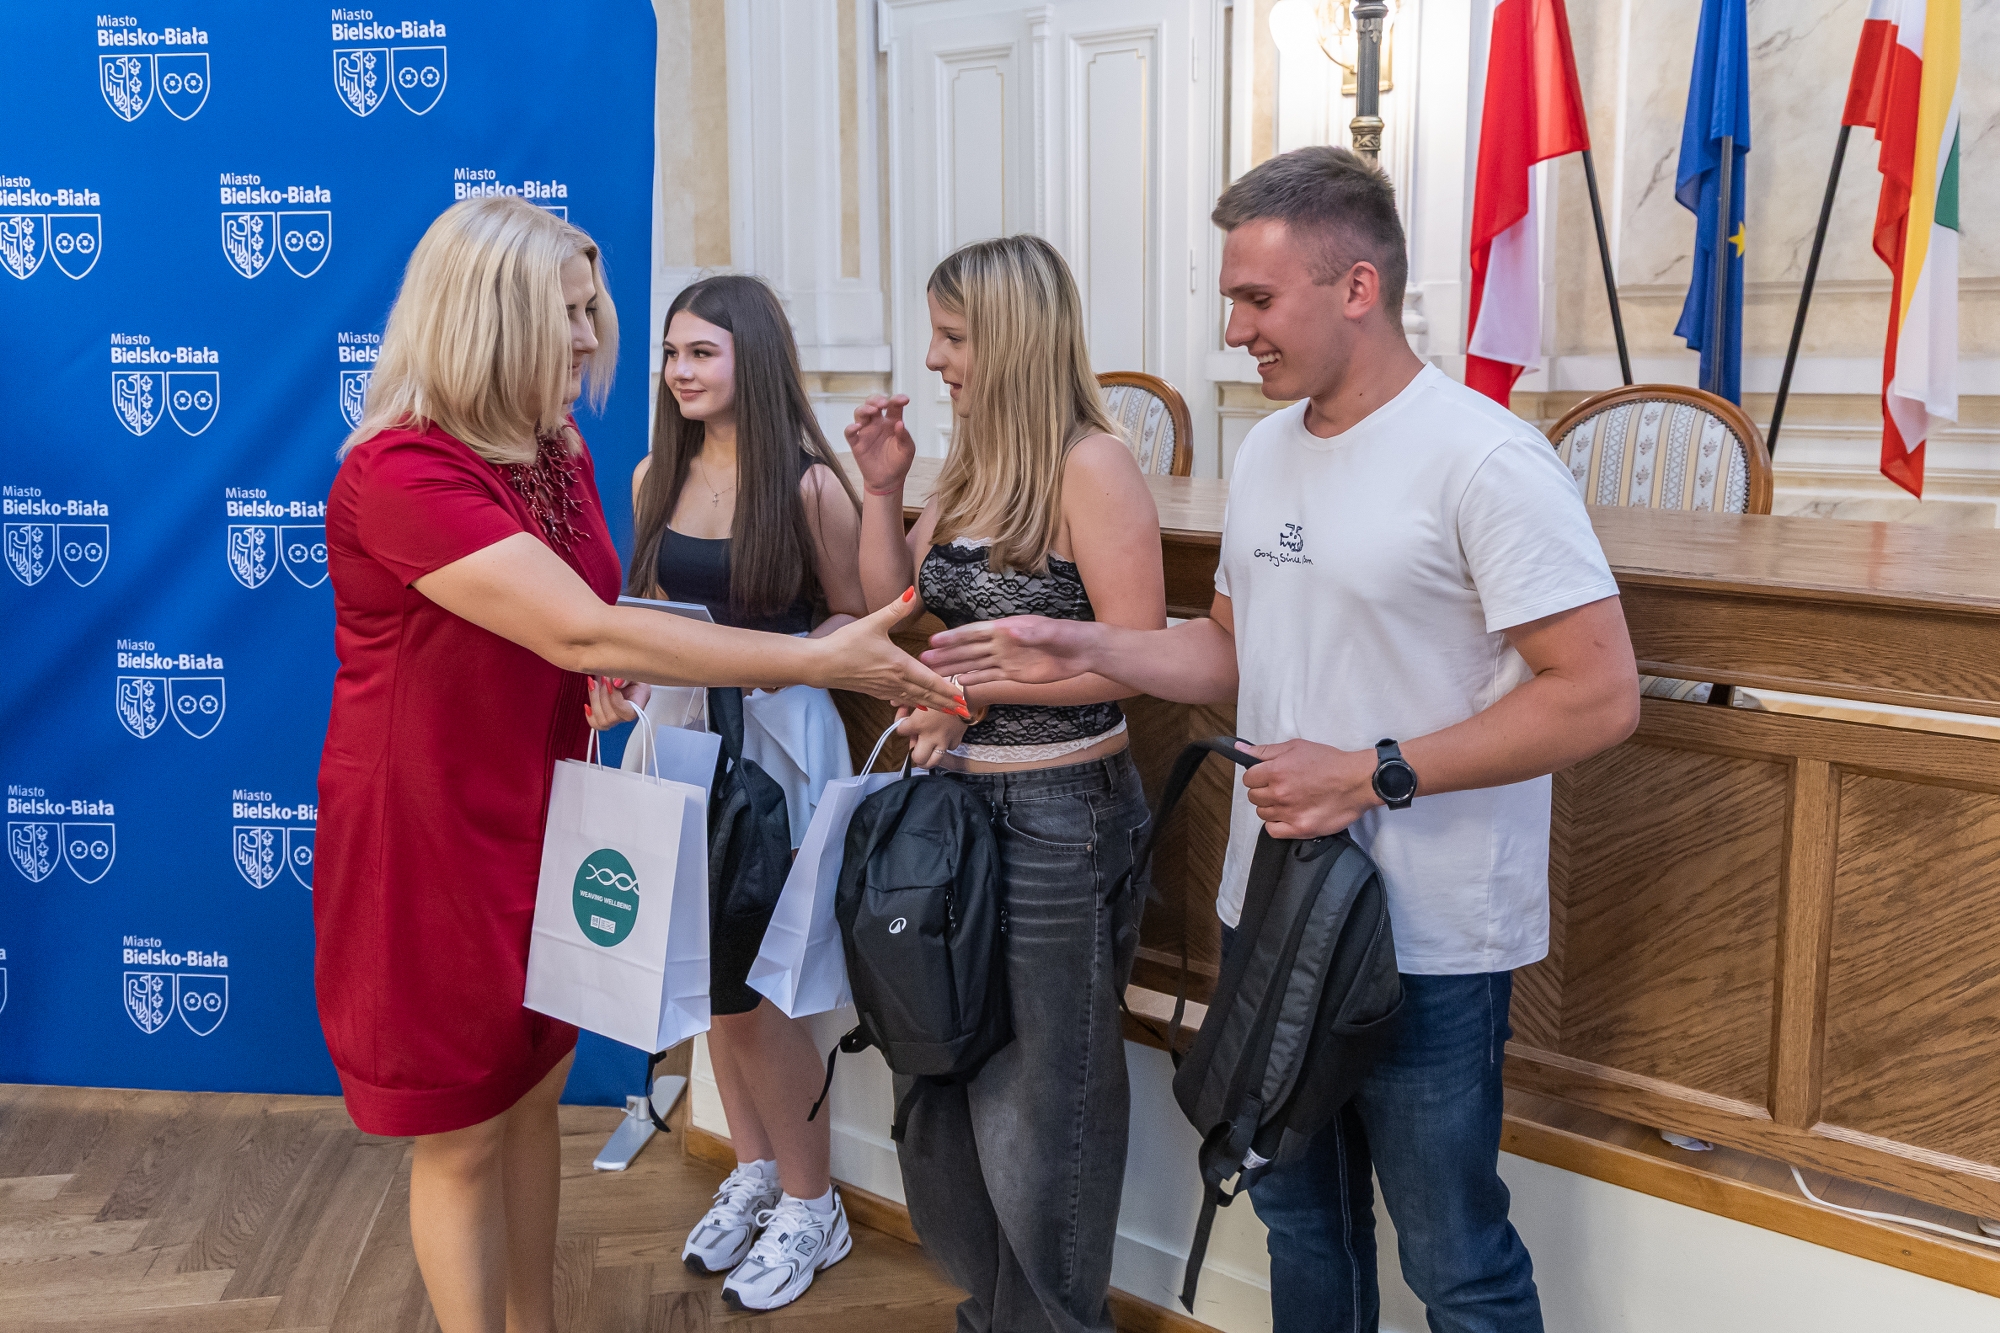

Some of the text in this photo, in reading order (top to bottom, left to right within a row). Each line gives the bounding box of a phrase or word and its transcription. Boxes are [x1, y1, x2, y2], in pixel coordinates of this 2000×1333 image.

[97, 15, 137, 26] Miasto
[332, 8, 373, 20] Miasto
[98, 27, 208, 46] Bielsko-Biała
[332, 20, 446, 40] Bielsko-Biała
[0, 175, 30, 187] iasto
[220, 173, 260, 185] Miasto
[454, 168, 496, 180] Miasto
[221, 184, 331, 204] Bielsko-Biała
[455, 179, 567, 199] Bielsko-Biała
[0, 189, 100, 206] ielsko-Biała
[111, 333, 150, 344] Miasto
[338, 332, 380, 344] Miasto
[111, 347, 219, 363] Bielsko-Biała
[3, 486, 41, 496] Miasto
[226, 487, 266, 498] Miasto
[3, 499, 108, 516] Bielsko-Biała
[227, 500, 326, 517] Bielsko-Biał
[118, 639, 155, 650] Miasto
[118, 653, 223, 669] Bielsko-Biała
[9, 785, 44, 796] Miasto
[233, 789, 272, 801] Miasto
[8, 798, 114, 815] Bielsko-Biała
[233, 803, 317, 820] Bielsko-Bi
[579, 889, 632, 911] WEAVING WELLBEING
[123, 936, 161, 947] Miasto
[123, 949, 228, 967] Bielsko-Biała
